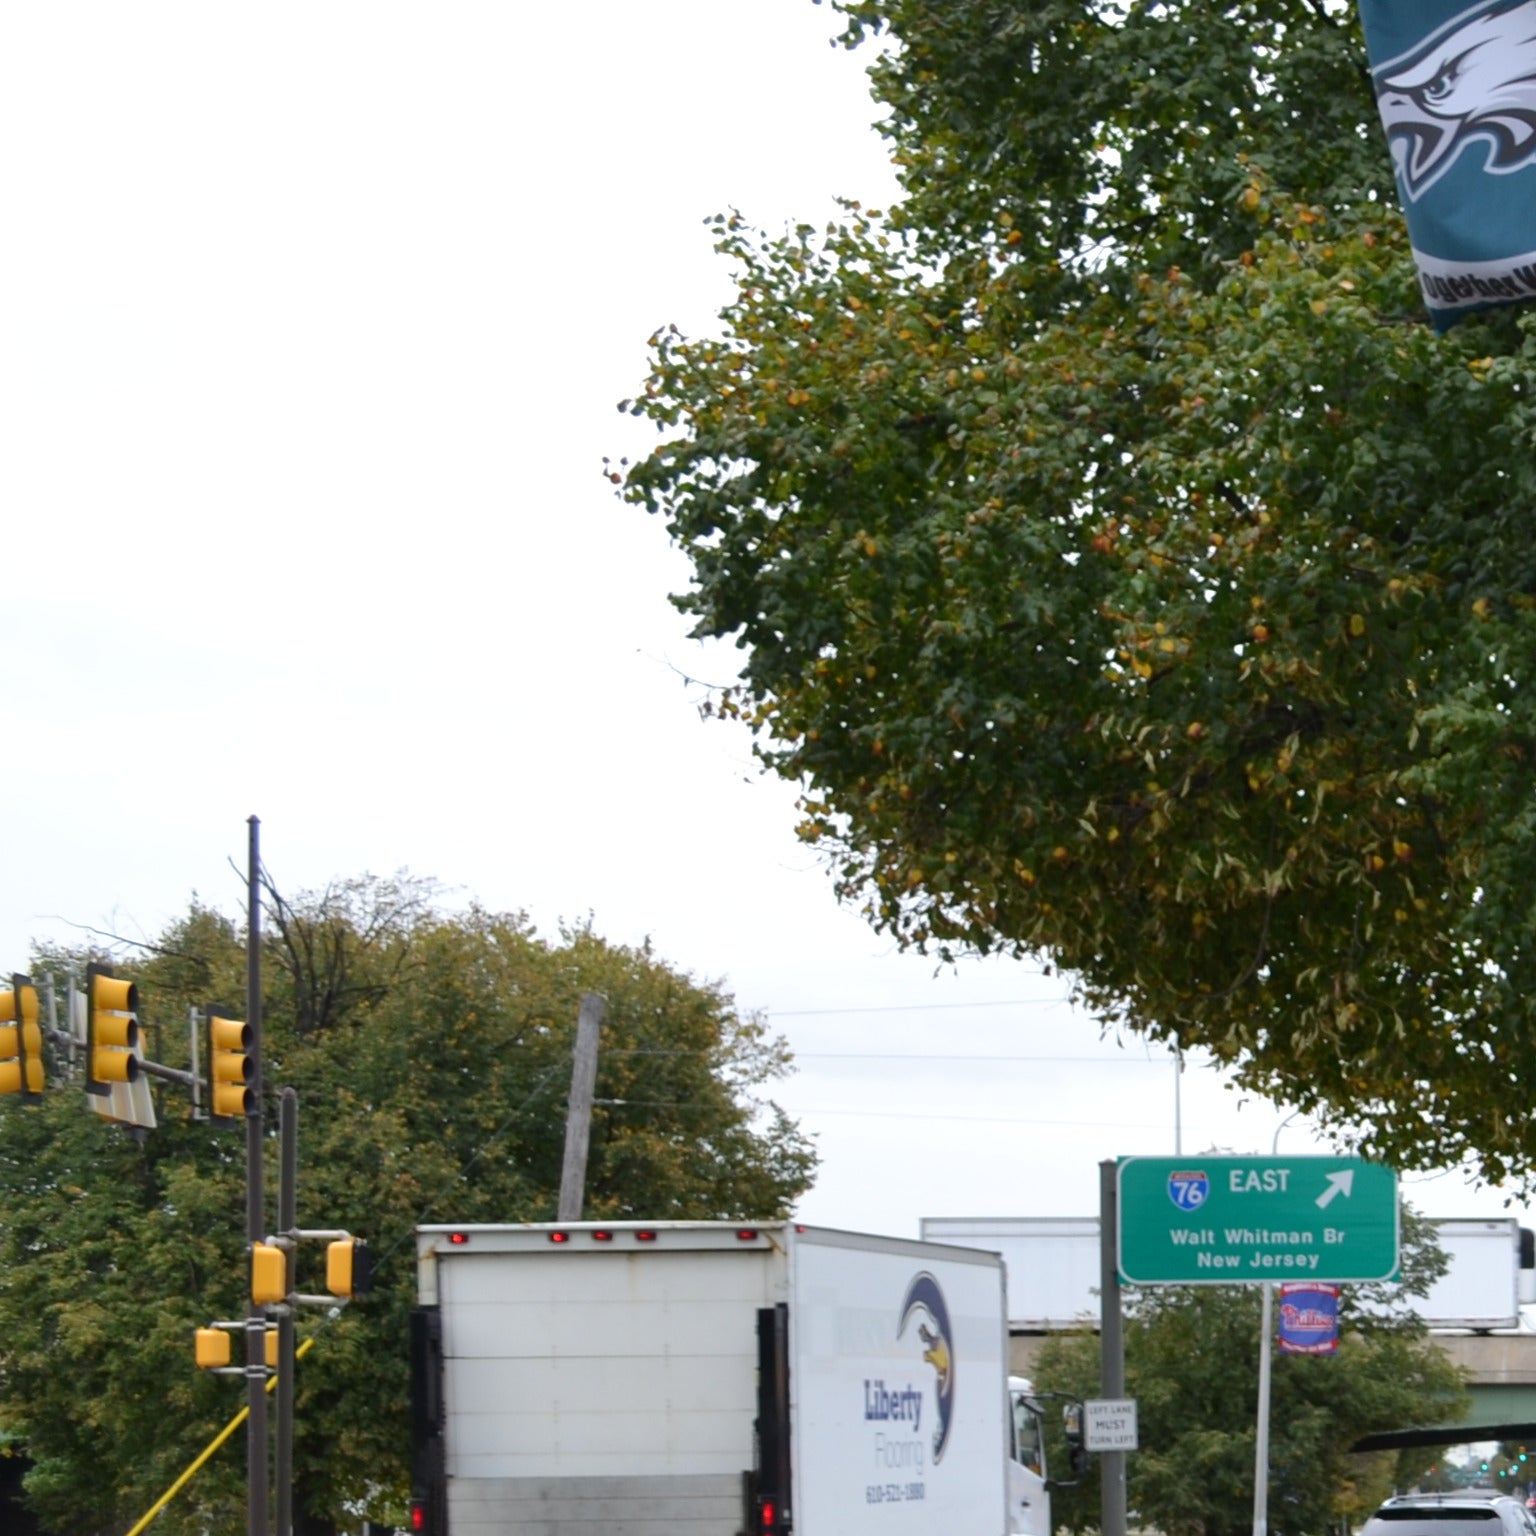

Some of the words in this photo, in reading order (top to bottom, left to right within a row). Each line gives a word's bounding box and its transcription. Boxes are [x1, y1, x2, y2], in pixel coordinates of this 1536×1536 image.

[1173, 1181, 1203, 1205] 76
[1229, 1169, 1291, 1193] EAST
[1170, 1228, 1215, 1246] Walt
[1224, 1227, 1313, 1245] Whitman
[1323, 1227, 1346, 1244] Br
[1197, 1252, 1241, 1268] New
[1249, 1251, 1320, 1271] Jersey
[864, 1379, 923, 1432] Liberty
[1090, 1406, 1108, 1414] LEFT
[1111, 1405, 1132, 1414] LANE
[1096, 1419, 1125, 1430] MUST
[1090, 1436, 1112, 1444] TURN
[1114, 1435, 1134, 1444] LEFT
[874, 1432, 925, 1476] Flooring
